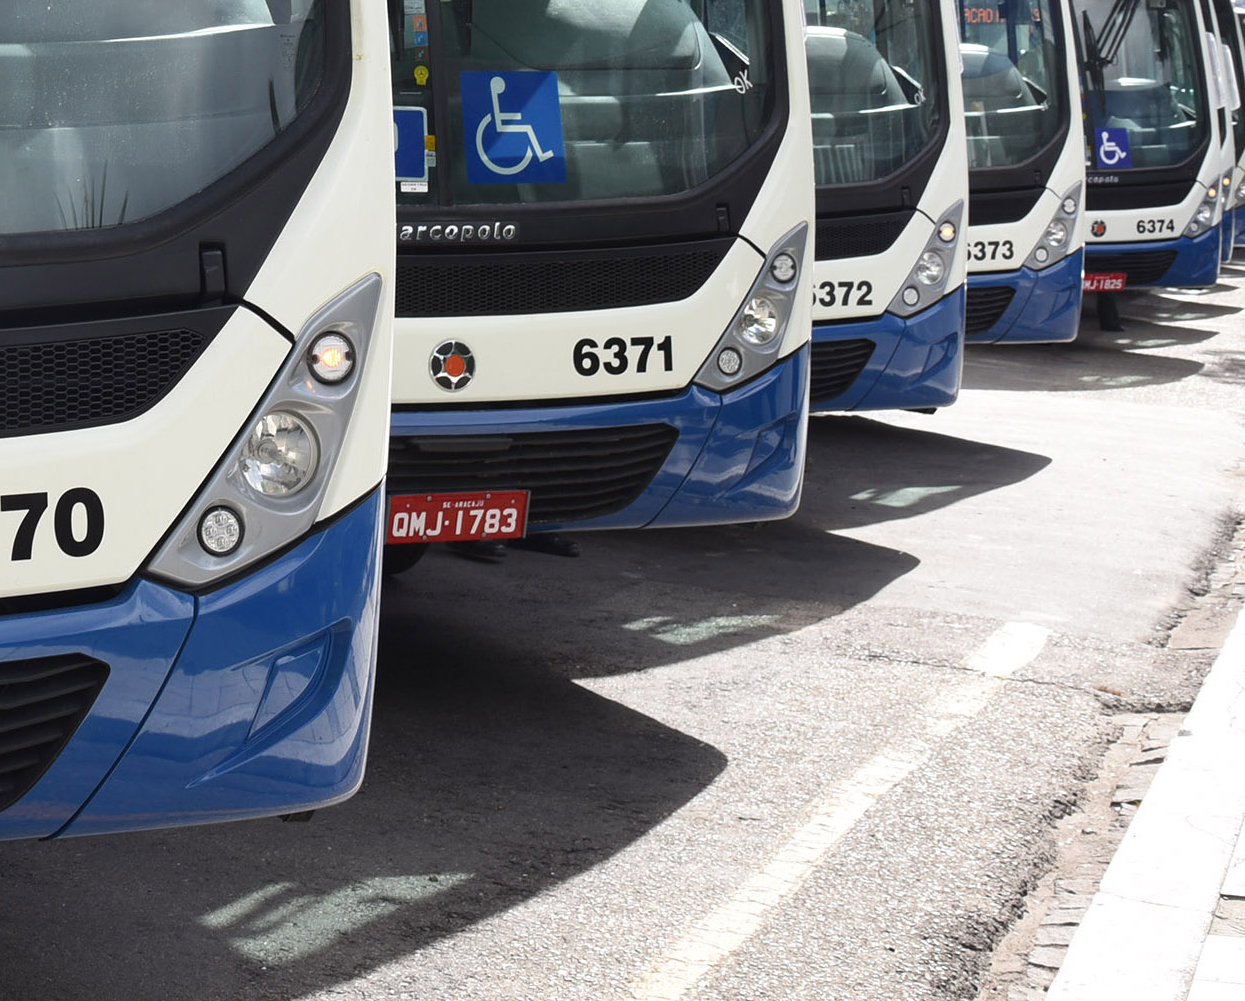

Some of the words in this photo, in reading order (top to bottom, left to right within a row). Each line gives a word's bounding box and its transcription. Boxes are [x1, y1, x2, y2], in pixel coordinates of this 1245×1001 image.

[399, 221, 516, 242] arcopolo
[1136, 219, 1175, 234] 6374
[572, 335, 674, 377] 6371
